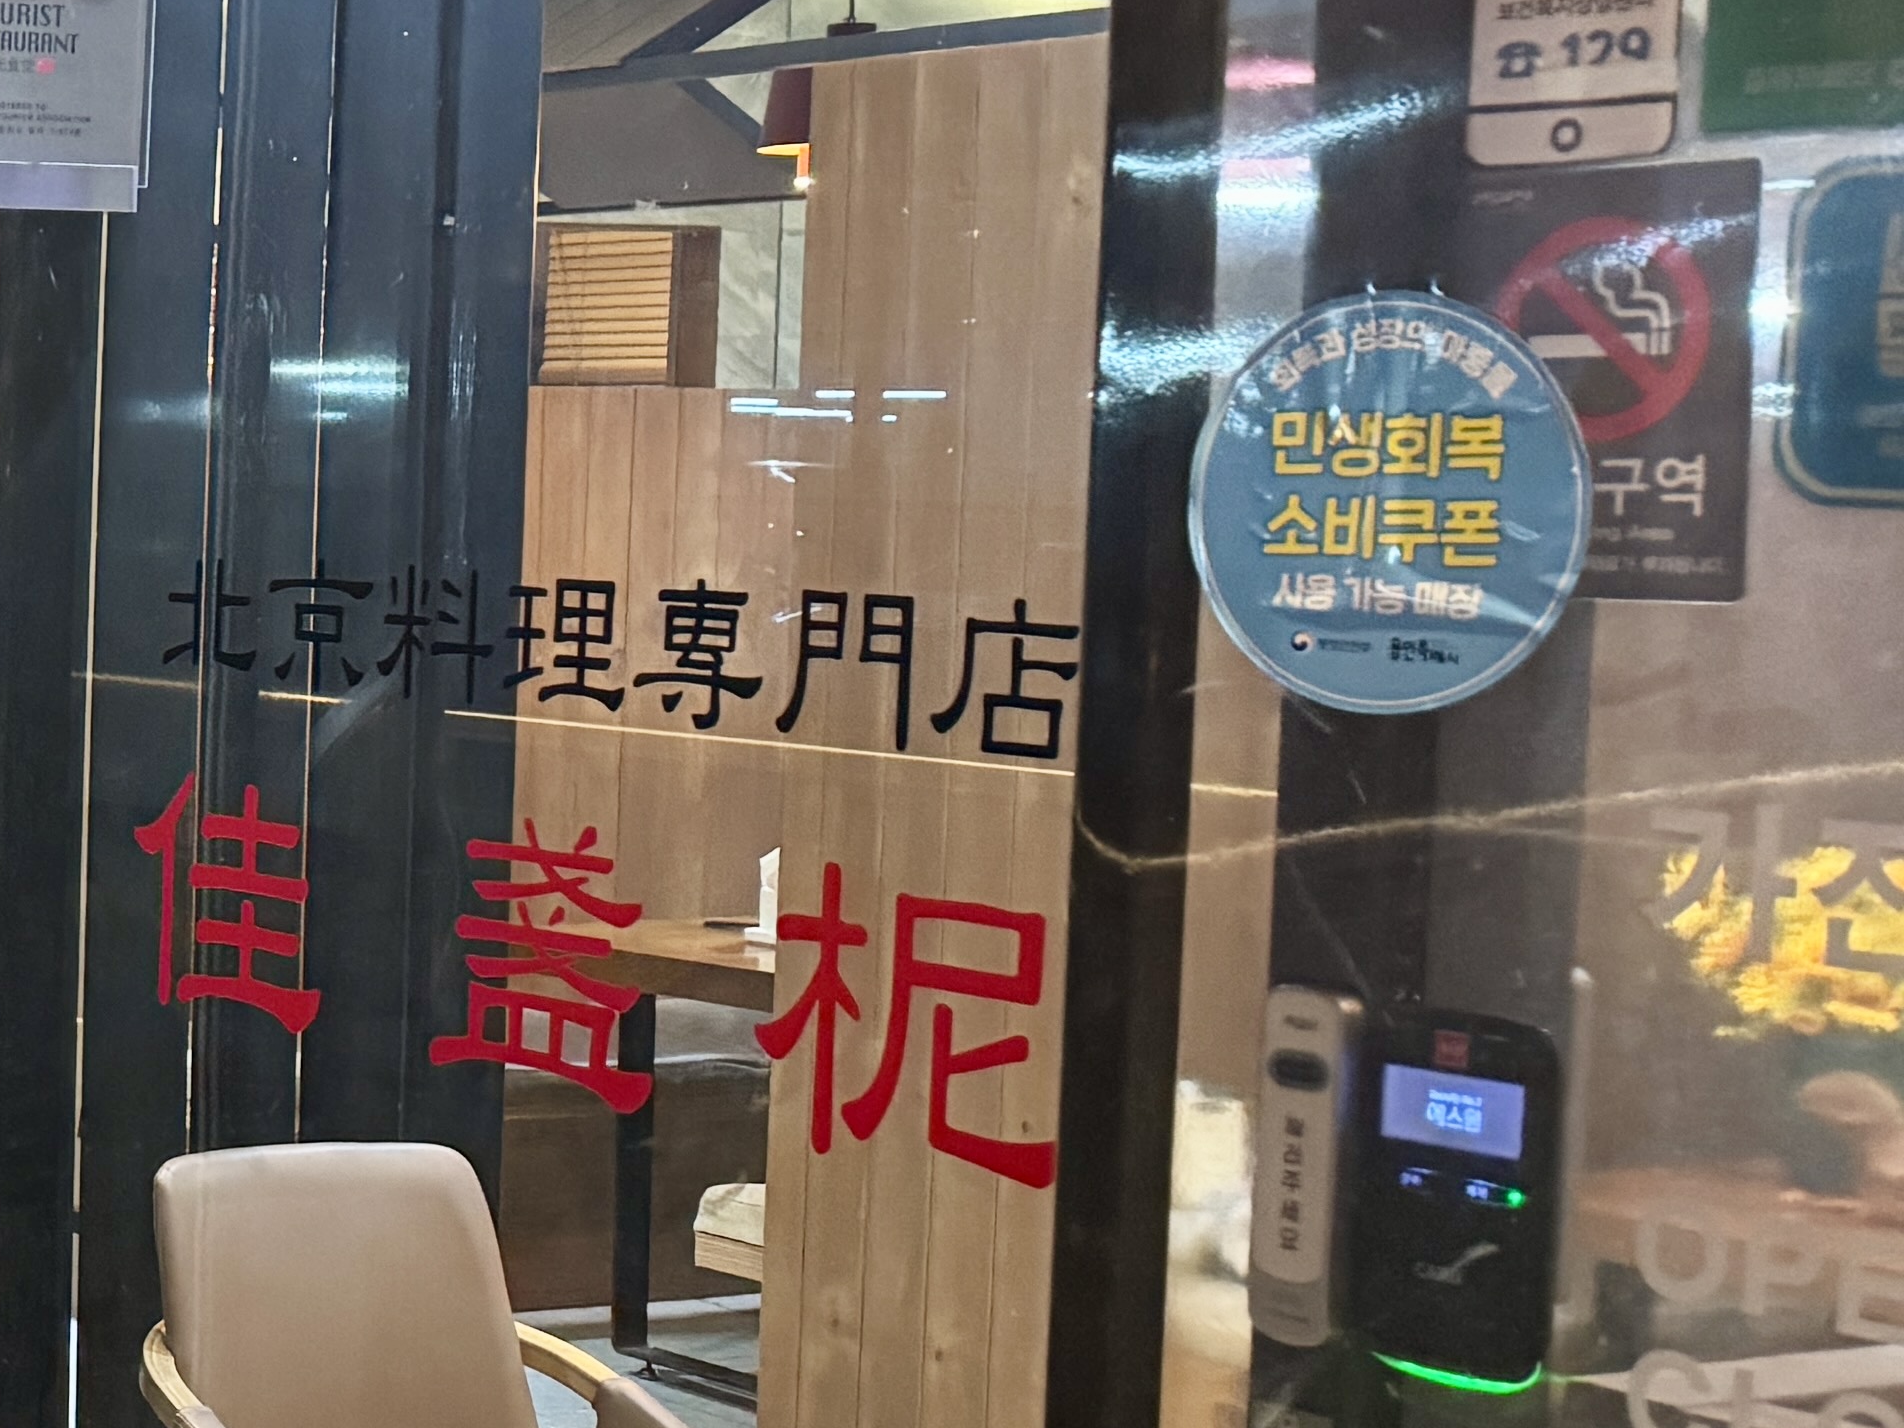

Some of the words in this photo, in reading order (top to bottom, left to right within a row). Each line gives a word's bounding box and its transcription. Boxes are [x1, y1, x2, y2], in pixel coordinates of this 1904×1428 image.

[1560, 26, 1652, 68] 129
[1270, 410, 1506, 480] 민생회복
[1262, 494, 1501, 568] 소비쿠폰
[1271, 572, 1337, 612] 사용
[1343, 575, 1406, 615] 가능
[1414, 581, 1485, 621] 매장
[162, 558, 1080, 760] 北京料理專門店
[1427, 1101, 1483, 1134] 에스원
